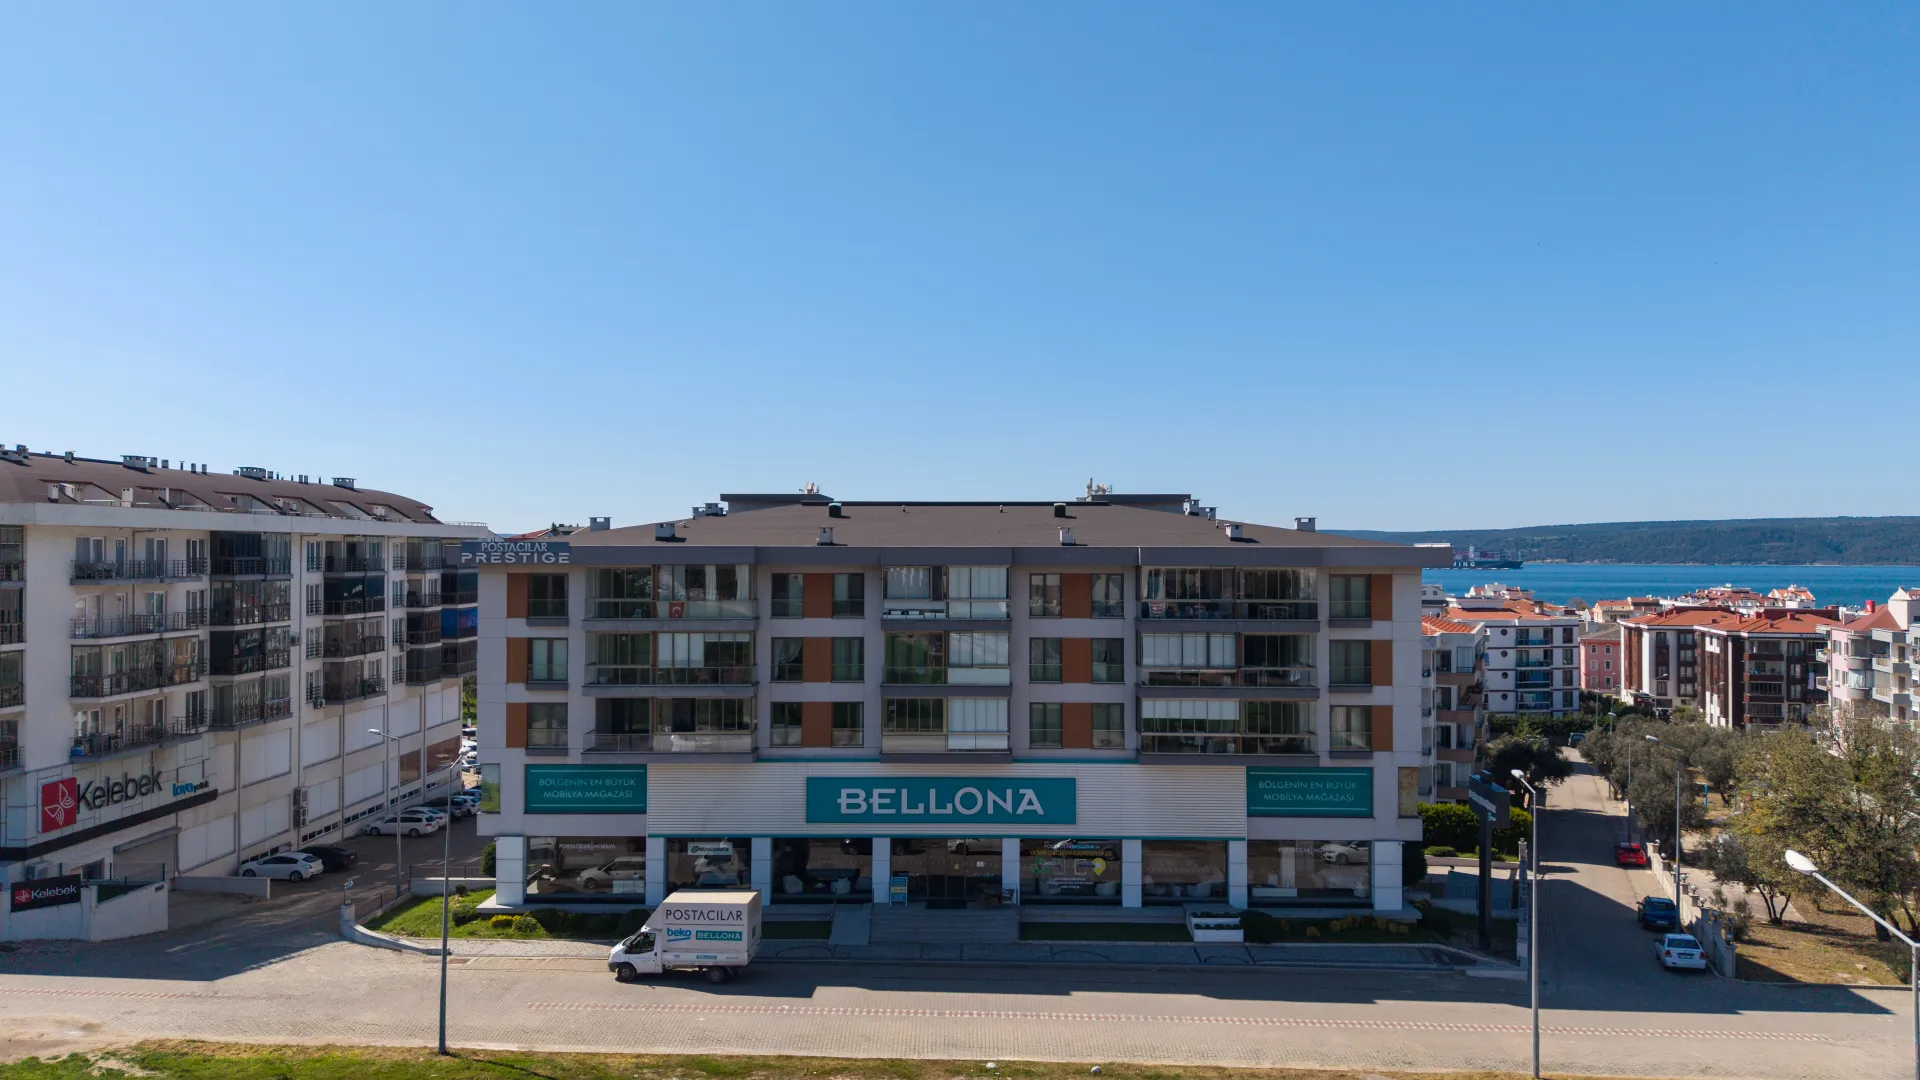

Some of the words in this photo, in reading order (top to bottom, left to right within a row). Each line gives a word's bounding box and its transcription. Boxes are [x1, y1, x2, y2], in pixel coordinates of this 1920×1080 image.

[481, 542, 547, 552] POSTACILAR
[461, 553, 569, 564] PRESTIGE
[77, 766, 162, 814] Kelebek
[1310, 781, 1323, 789] EN
[837, 787, 1044, 815] BELLONA
[31, 885, 76, 899] Kelebek
[666, 909, 743, 921] POSTACILAR
[667, 927, 691, 937] beko
[697, 932, 740, 940] BELLONA
